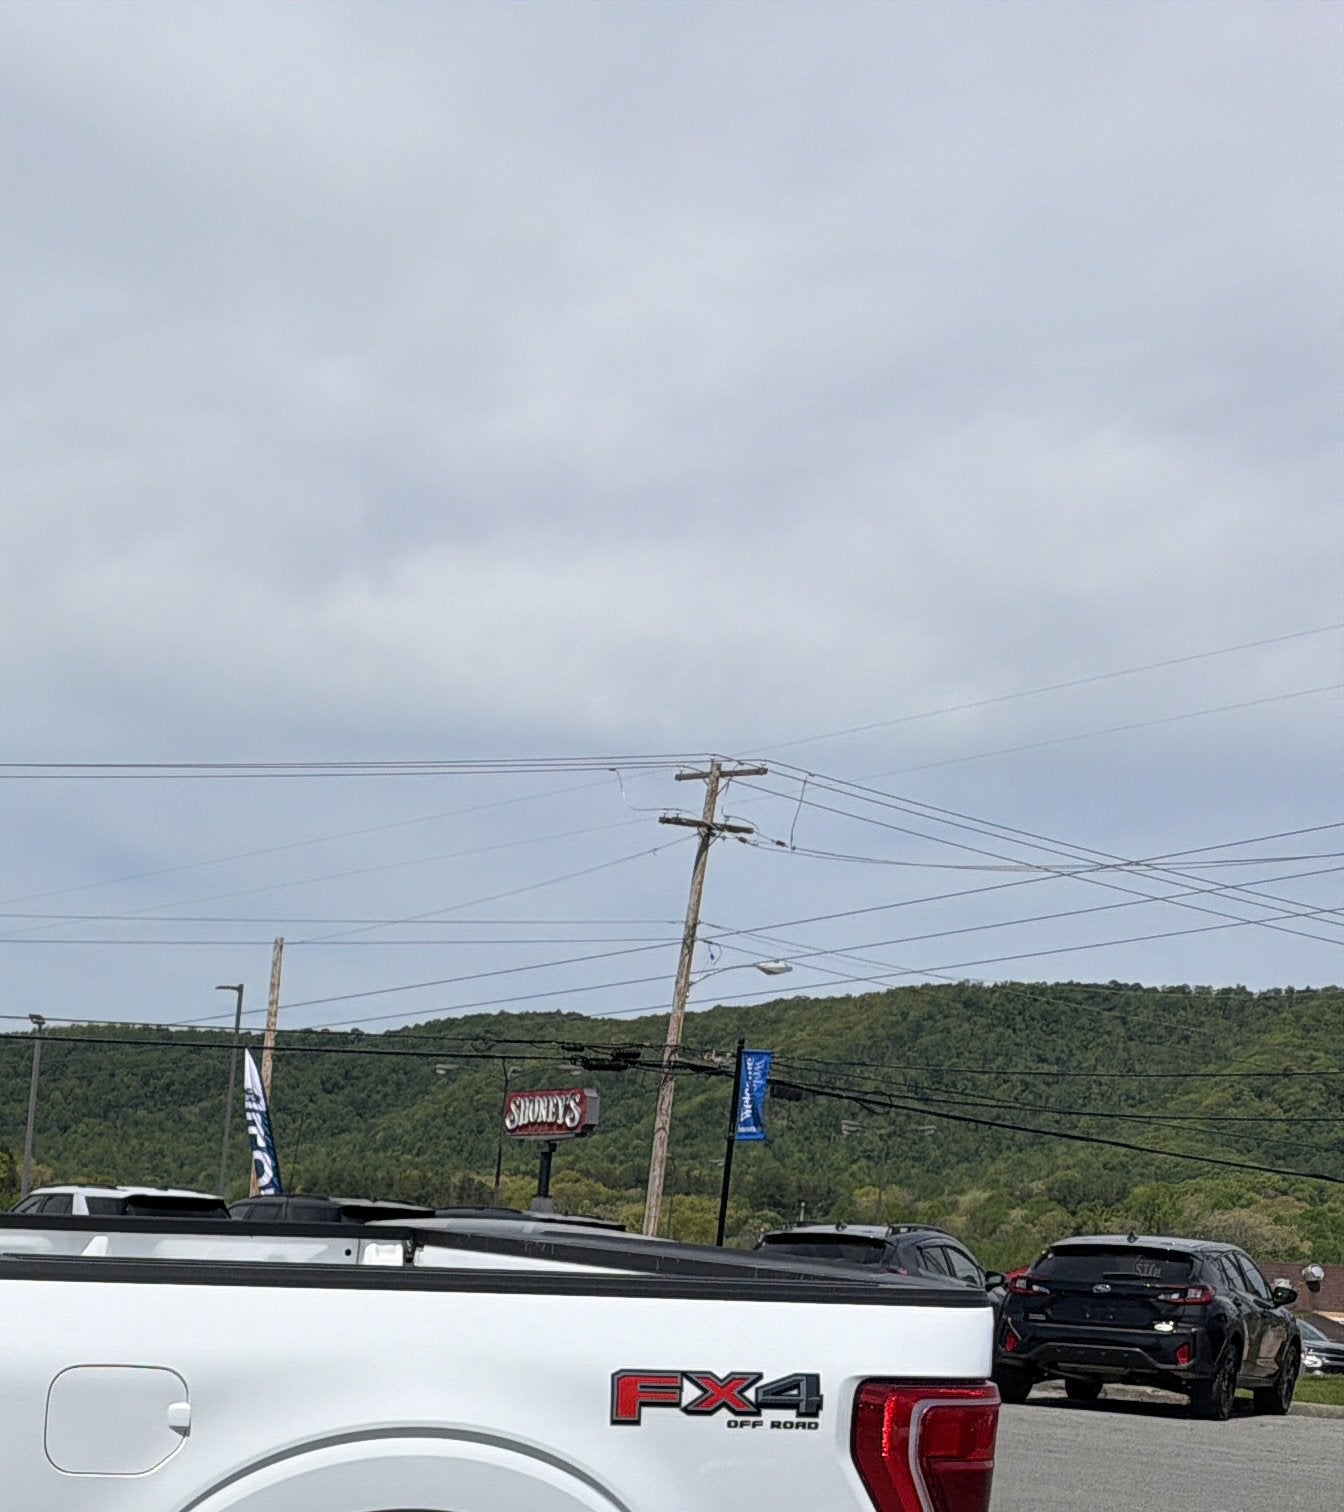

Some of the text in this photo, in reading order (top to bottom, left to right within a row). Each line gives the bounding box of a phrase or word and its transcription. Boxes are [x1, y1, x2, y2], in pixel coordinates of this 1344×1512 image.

[505, 1093, 582, 1131] SHONEY'S
[610, 1368, 823, 1426] FX4
[727, 1420, 820, 1430] OFF ROAD
